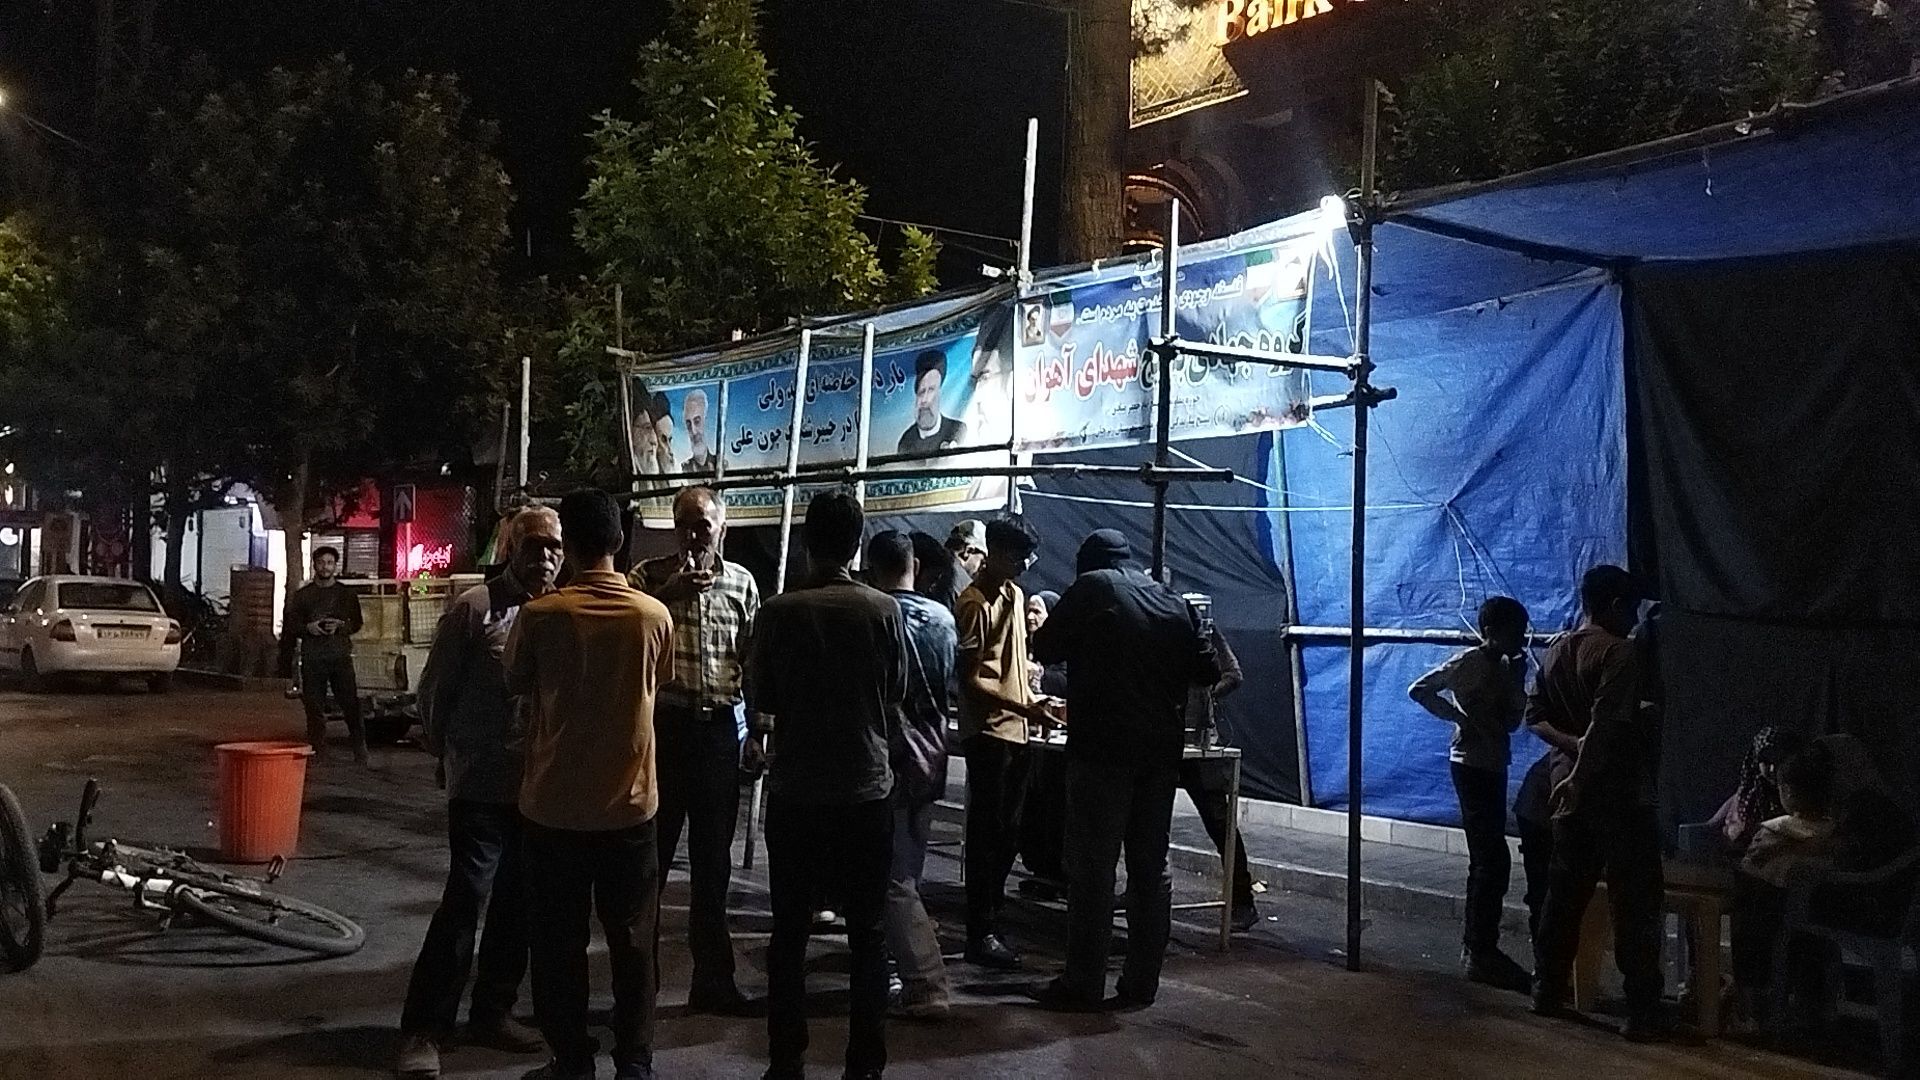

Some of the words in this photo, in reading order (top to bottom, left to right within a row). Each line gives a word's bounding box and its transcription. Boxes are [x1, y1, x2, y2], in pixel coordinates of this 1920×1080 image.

[1075, 339, 1140, 401] شهدای
[758, 378, 785, 411] ولی
[730, 423, 754, 455] علی
